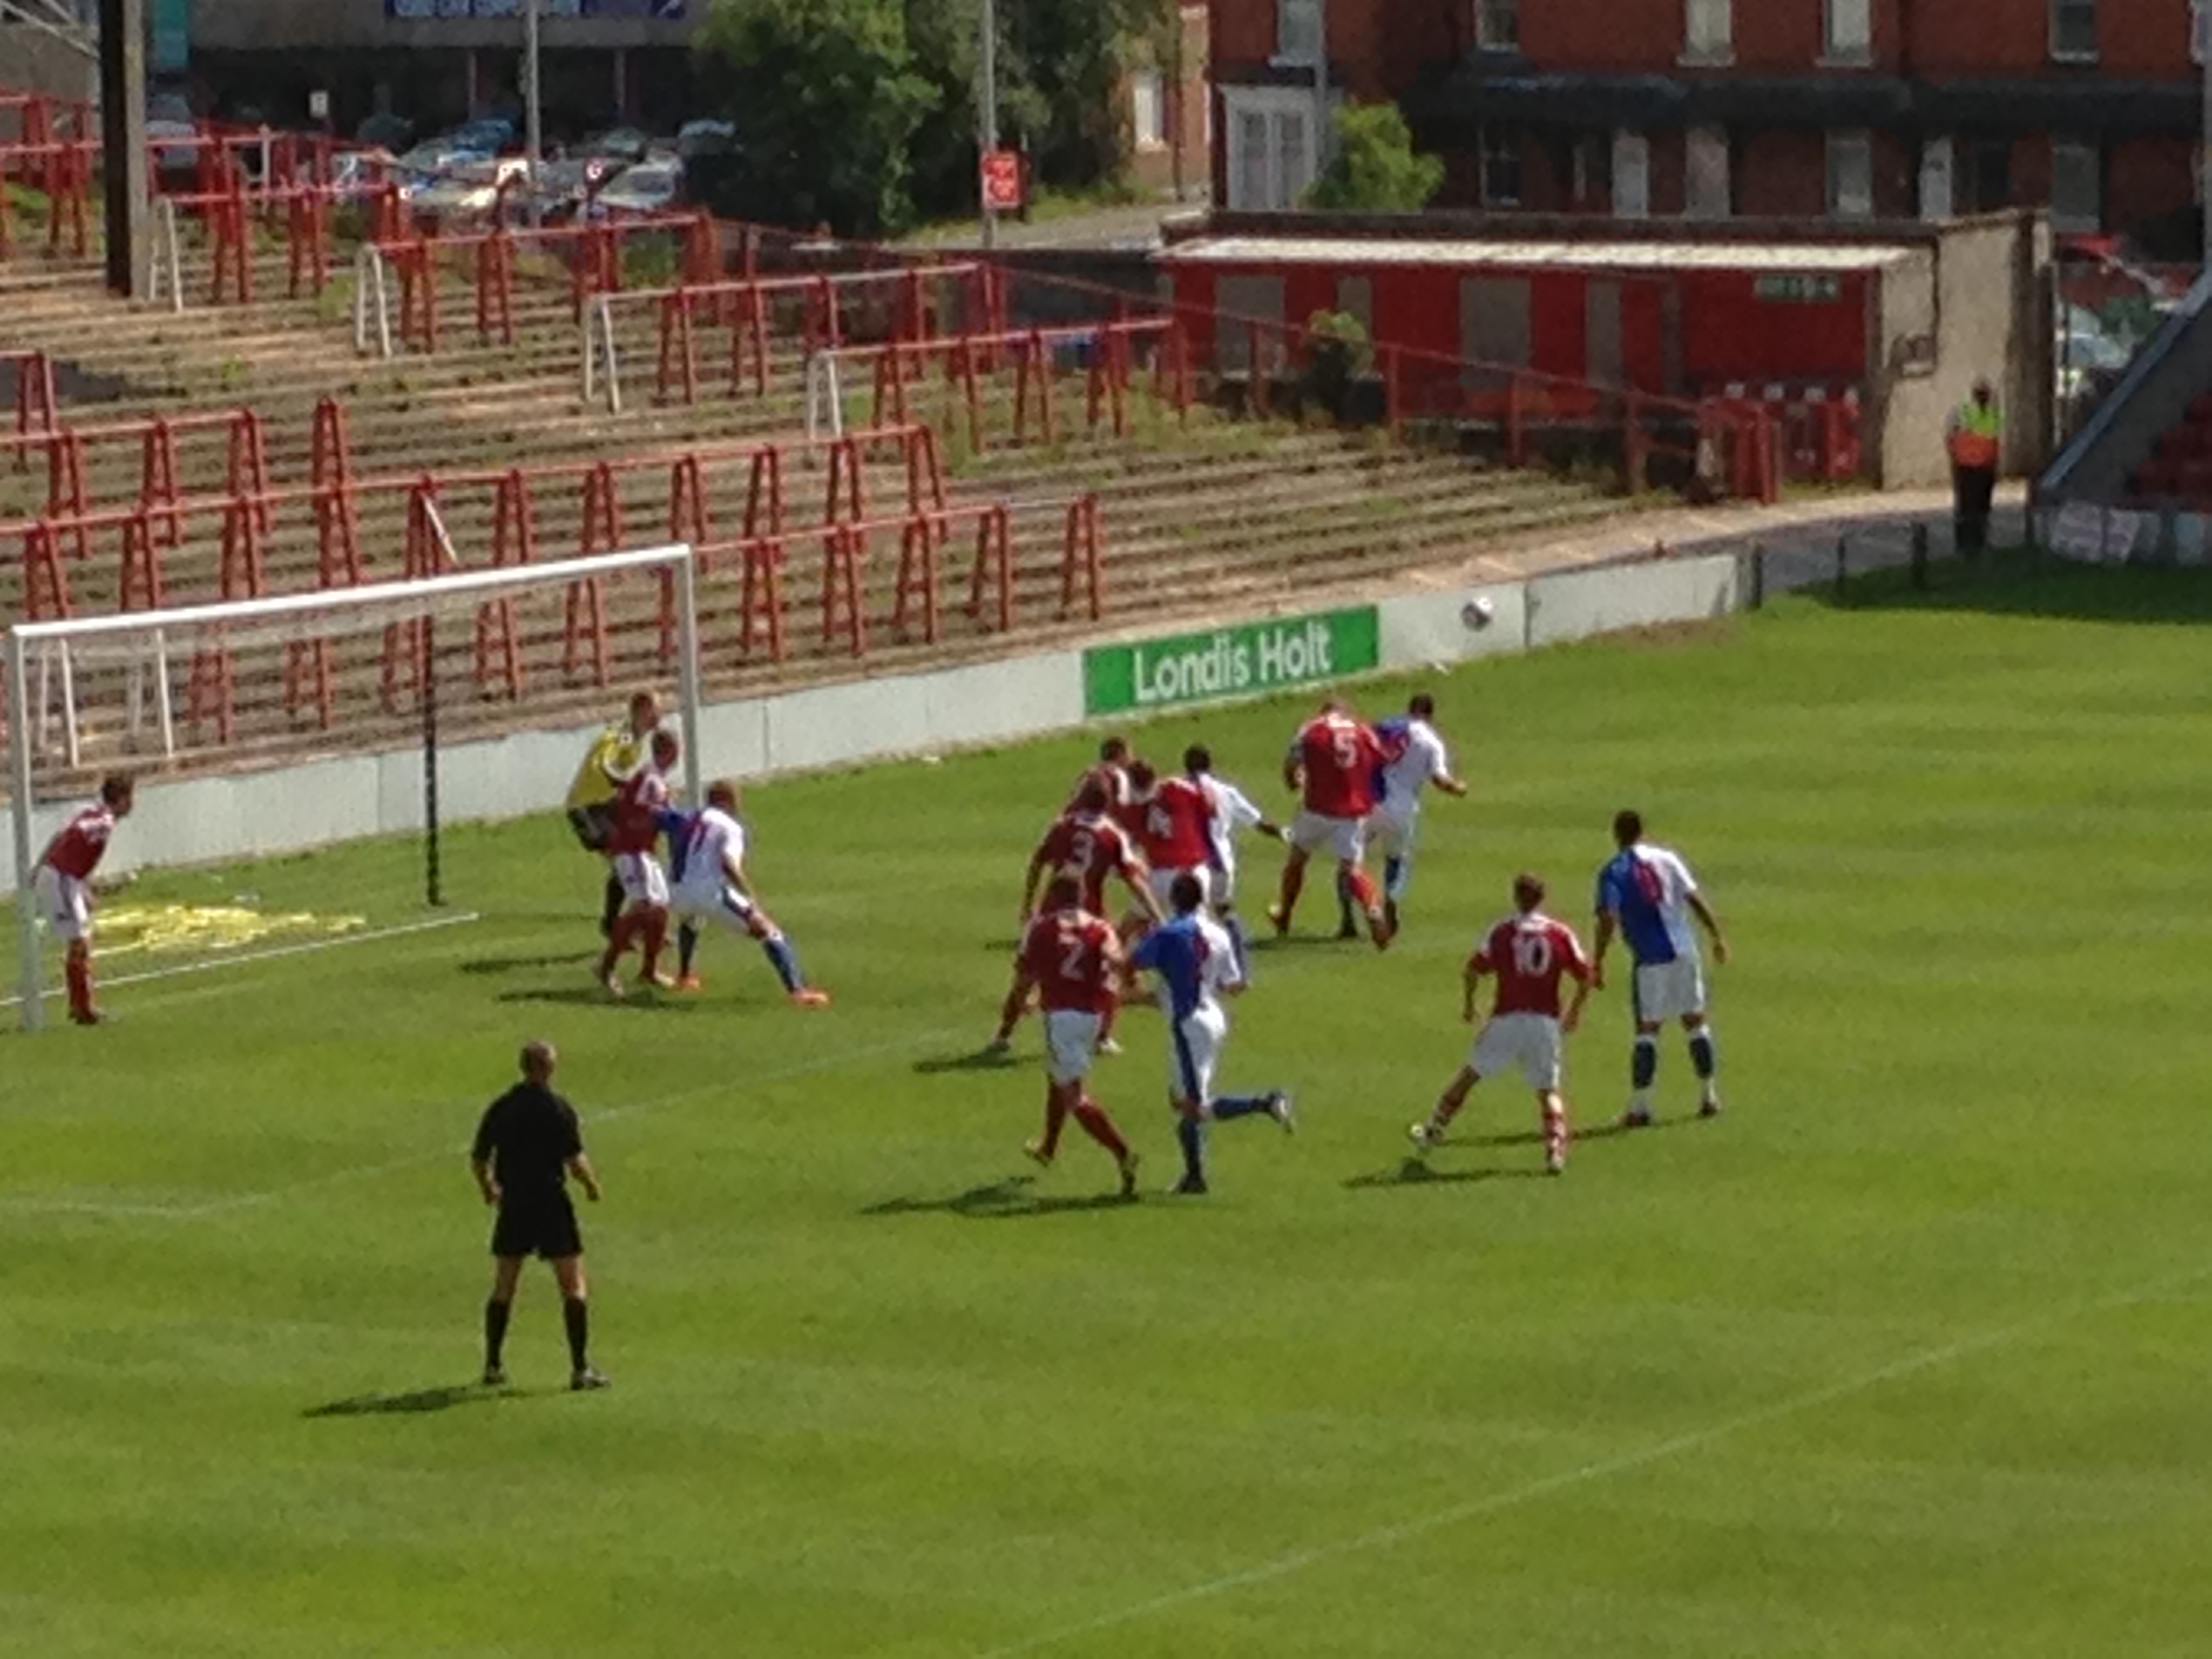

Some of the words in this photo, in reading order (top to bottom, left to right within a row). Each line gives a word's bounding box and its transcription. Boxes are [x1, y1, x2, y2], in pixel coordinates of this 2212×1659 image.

[1134, 637, 1248, 701] Londis
[1259, 622, 1330, 682] Holt
[1058, 934, 1085, 980] 2
[1511, 934, 1552, 977] 10
